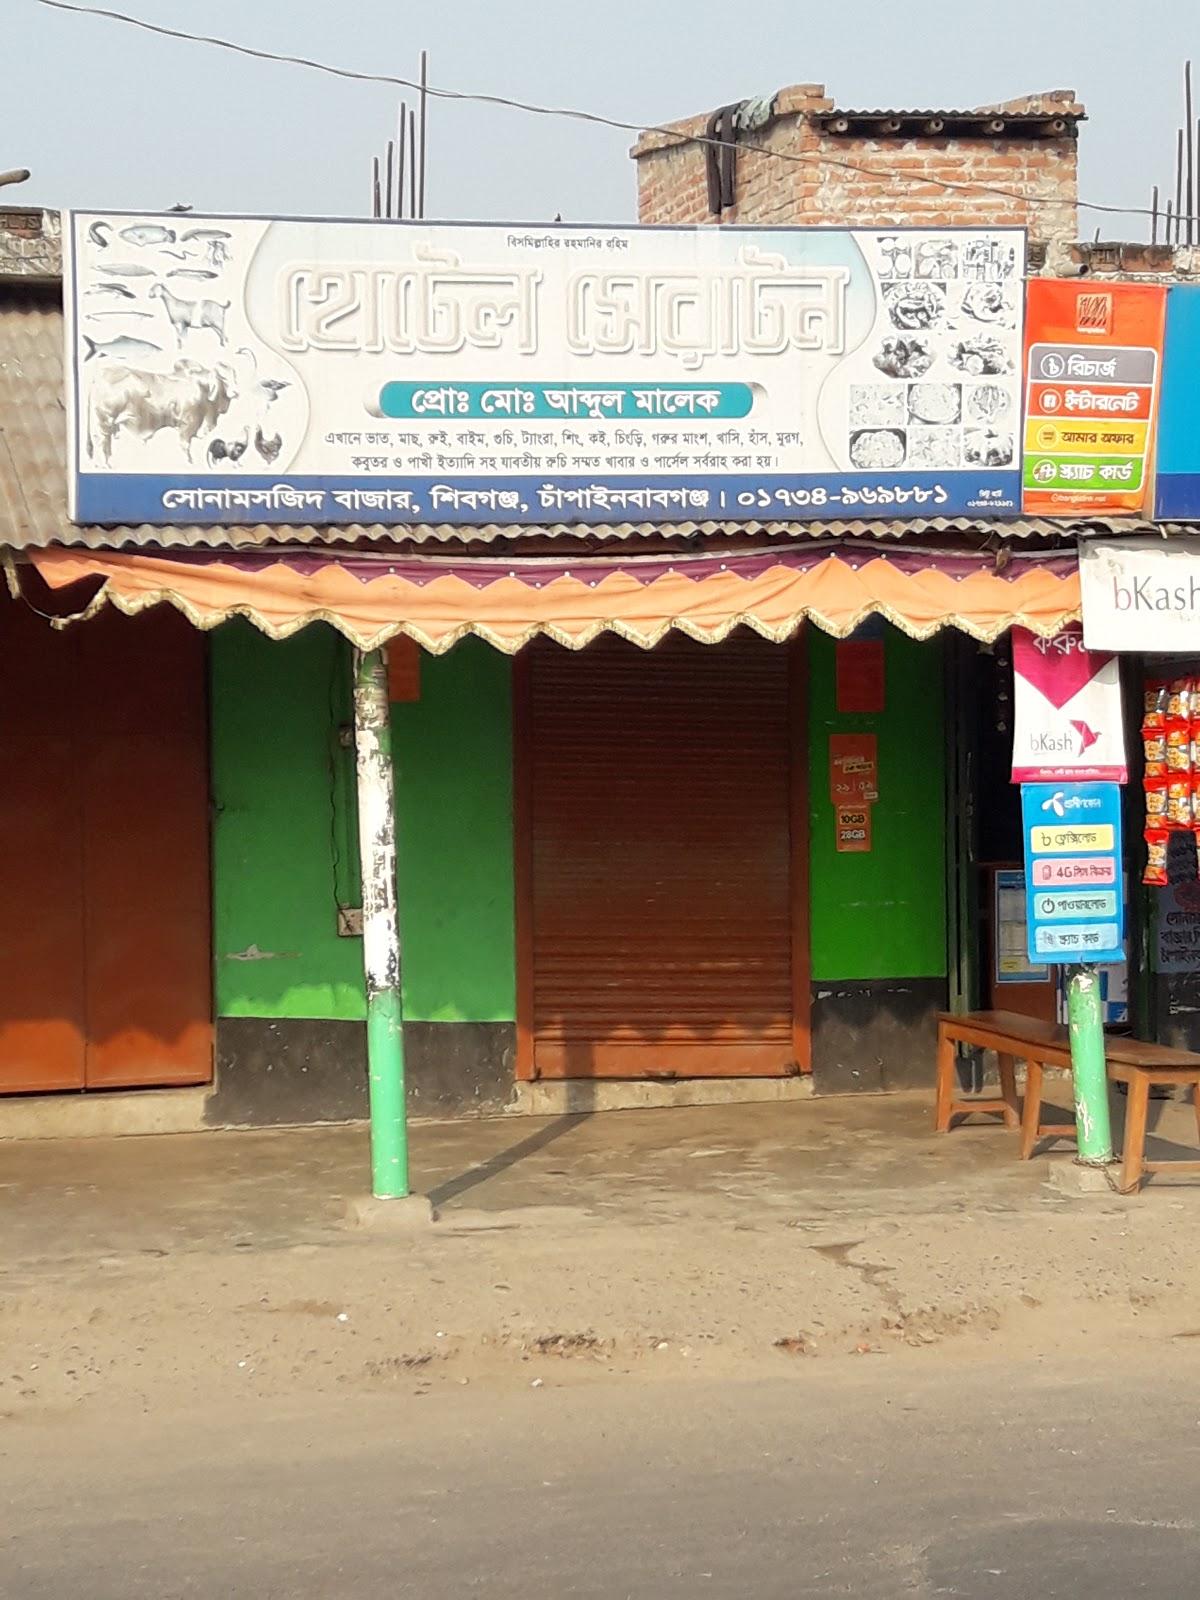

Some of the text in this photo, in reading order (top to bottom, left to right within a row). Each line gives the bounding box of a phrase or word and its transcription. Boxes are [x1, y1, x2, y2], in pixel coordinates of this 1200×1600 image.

[606, 236, 628, 249] রহিম
[279, 240, 850, 370] হোটেল সেরাটন
[1067, 354, 1117, 377] রিচার্জ
[481, 389, 535, 414] মোঃ
[543, 387, 626, 418] আব্দুল
[632, 389, 721, 414] মালেক
[1064, 389, 1140, 411] ইন্টারনেট
[325, 432, 361, 444] এখানে
[365, 432, 394, 447] ভাত,
[398, 433, 423, 448] মাছ,
[427, 430, 452, 447] রুই,
[456, 429, 489, 447] বাইম,
[561, 429, 584, 447] শিং,
[588, 430, 610, 447] কই,
[652, 433, 678, 445] গরুর
[716, 429, 744, 447] খাসি,
[748, 429, 772, 447] হাঁস,
[1061, 431, 1134, 444] আমার অফার
[351, 456, 388, 471] কবুতর
[393, 457, 402, 468] ও
[407, 452, 432, 469] পাখী
[436, 452, 475, 470] ইত্যাদি
[479, 456, 498, 470] সহ
[500, 452, 542, 469] যাবতীয়
[545, 452, 567, 469] রুচি
[572, 456, 601, 469] সম্মত
[605, 456, 635, 469] খাবার
[641, 457, 649, 468] ও
[654, 451, 689, 468] পার্সেল
[731, 456, 752, 468] করা
[1099, 461, 1135, 480] কার্ড
[162, 484, 324, 510] সোনামসজিদ
[334, 488, 420, 514] বাজার,
[428, 485, 529, 513] শিবগঞ্জ,
[536, 483, 710, 510] চাঁপাইনবাবগঞ্জ
[737, 485, 949, 508] ০১৭৩৪-৯৬৯৮৮১
[1113, 575, 1200, 612] bKash
[1030, 733, 1072, 752] bKash
[1056, 866, 1072, 878] 4G
